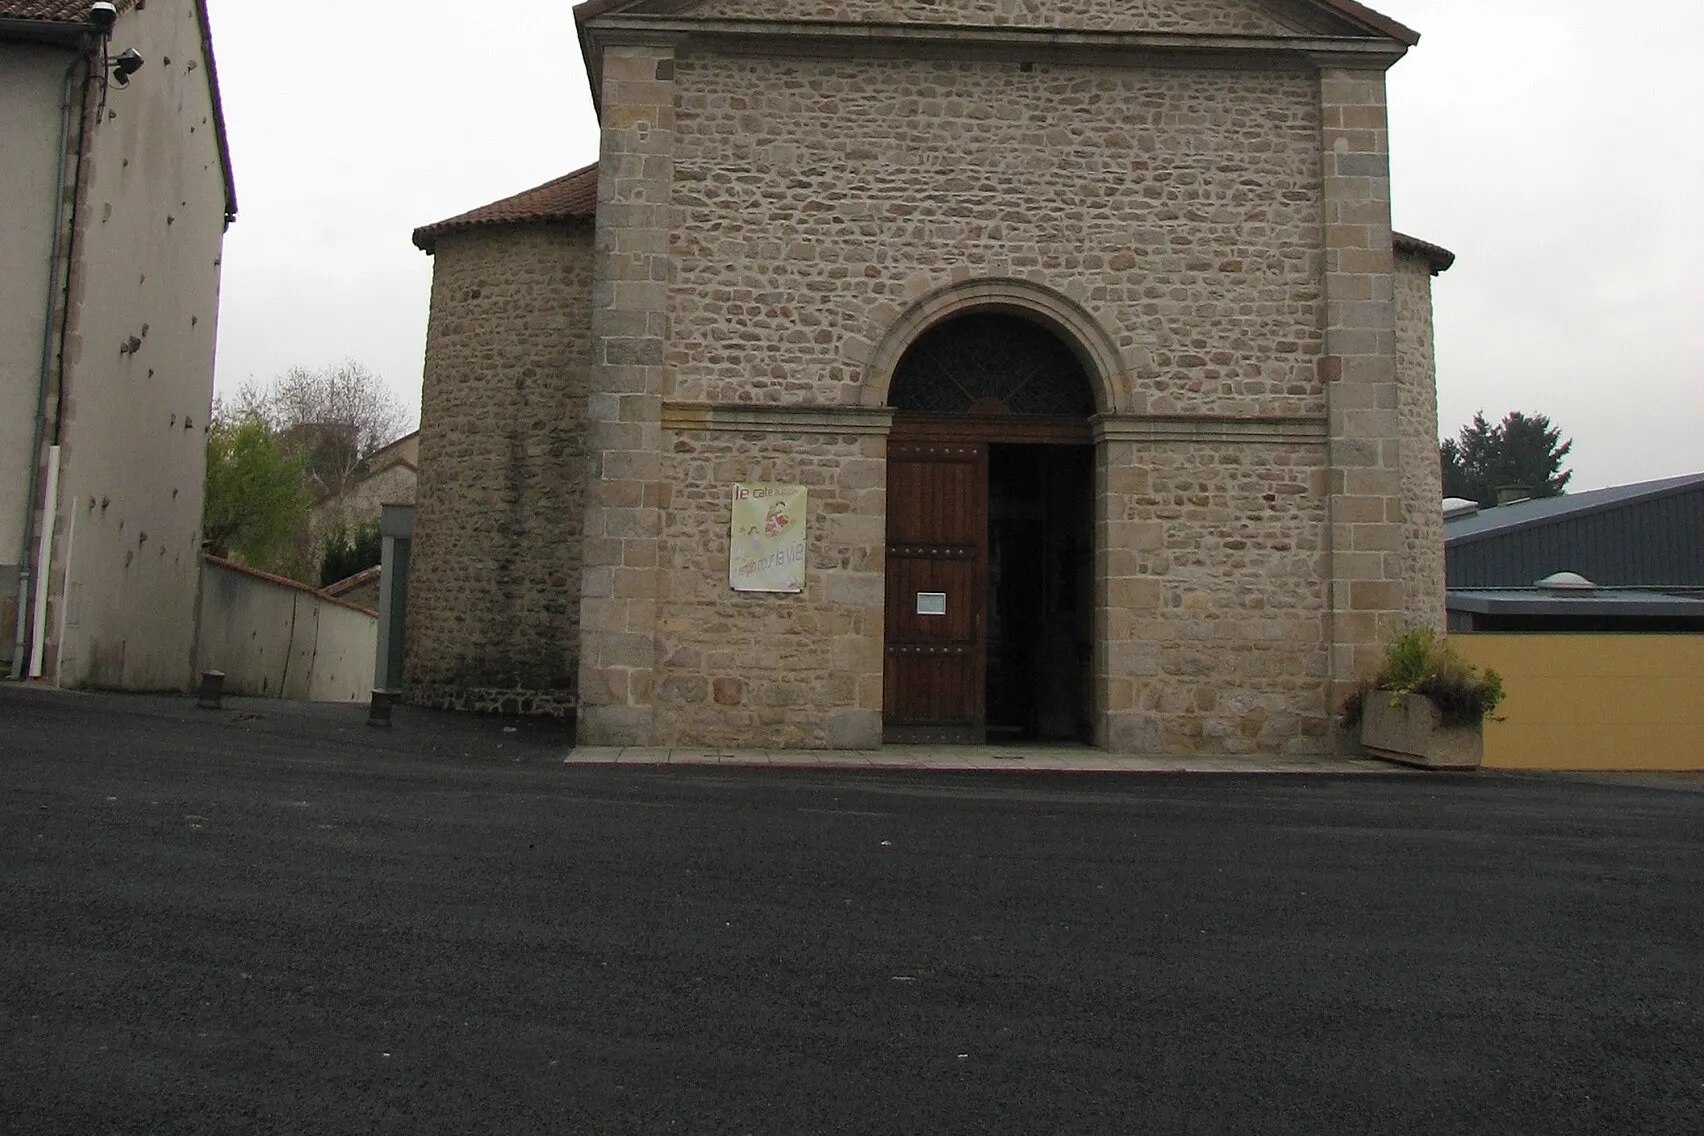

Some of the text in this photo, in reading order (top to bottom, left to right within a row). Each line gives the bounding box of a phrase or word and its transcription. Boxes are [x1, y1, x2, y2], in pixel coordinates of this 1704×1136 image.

[736, 486, 750, 500] le
[776, 547, 784, 566] la
[786, 541, 804, 562] vie
